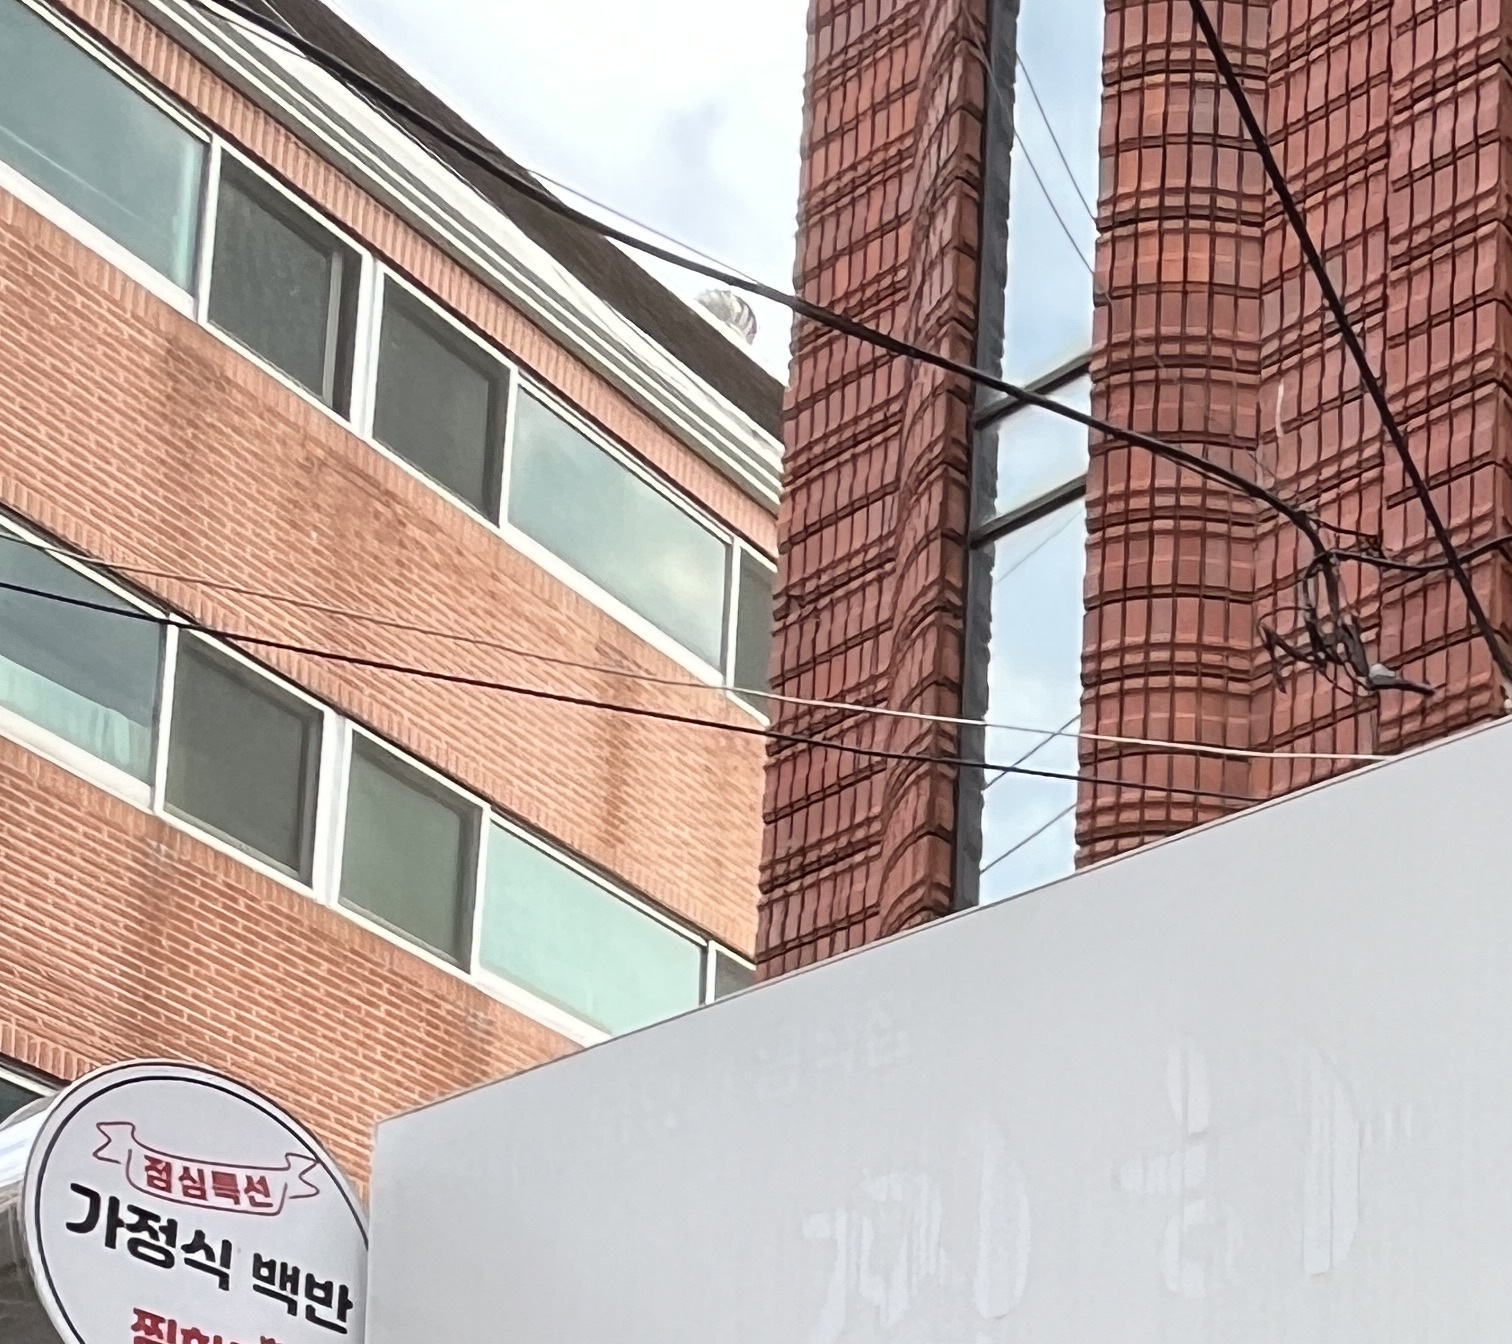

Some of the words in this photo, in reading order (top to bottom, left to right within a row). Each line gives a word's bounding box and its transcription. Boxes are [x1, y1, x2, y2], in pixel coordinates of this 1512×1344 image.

[143, 1154, 274, 1208] 점심특선
[65, 1183, 233, 1291] 가정식
[252, 1251, 354, 1334] 백반
